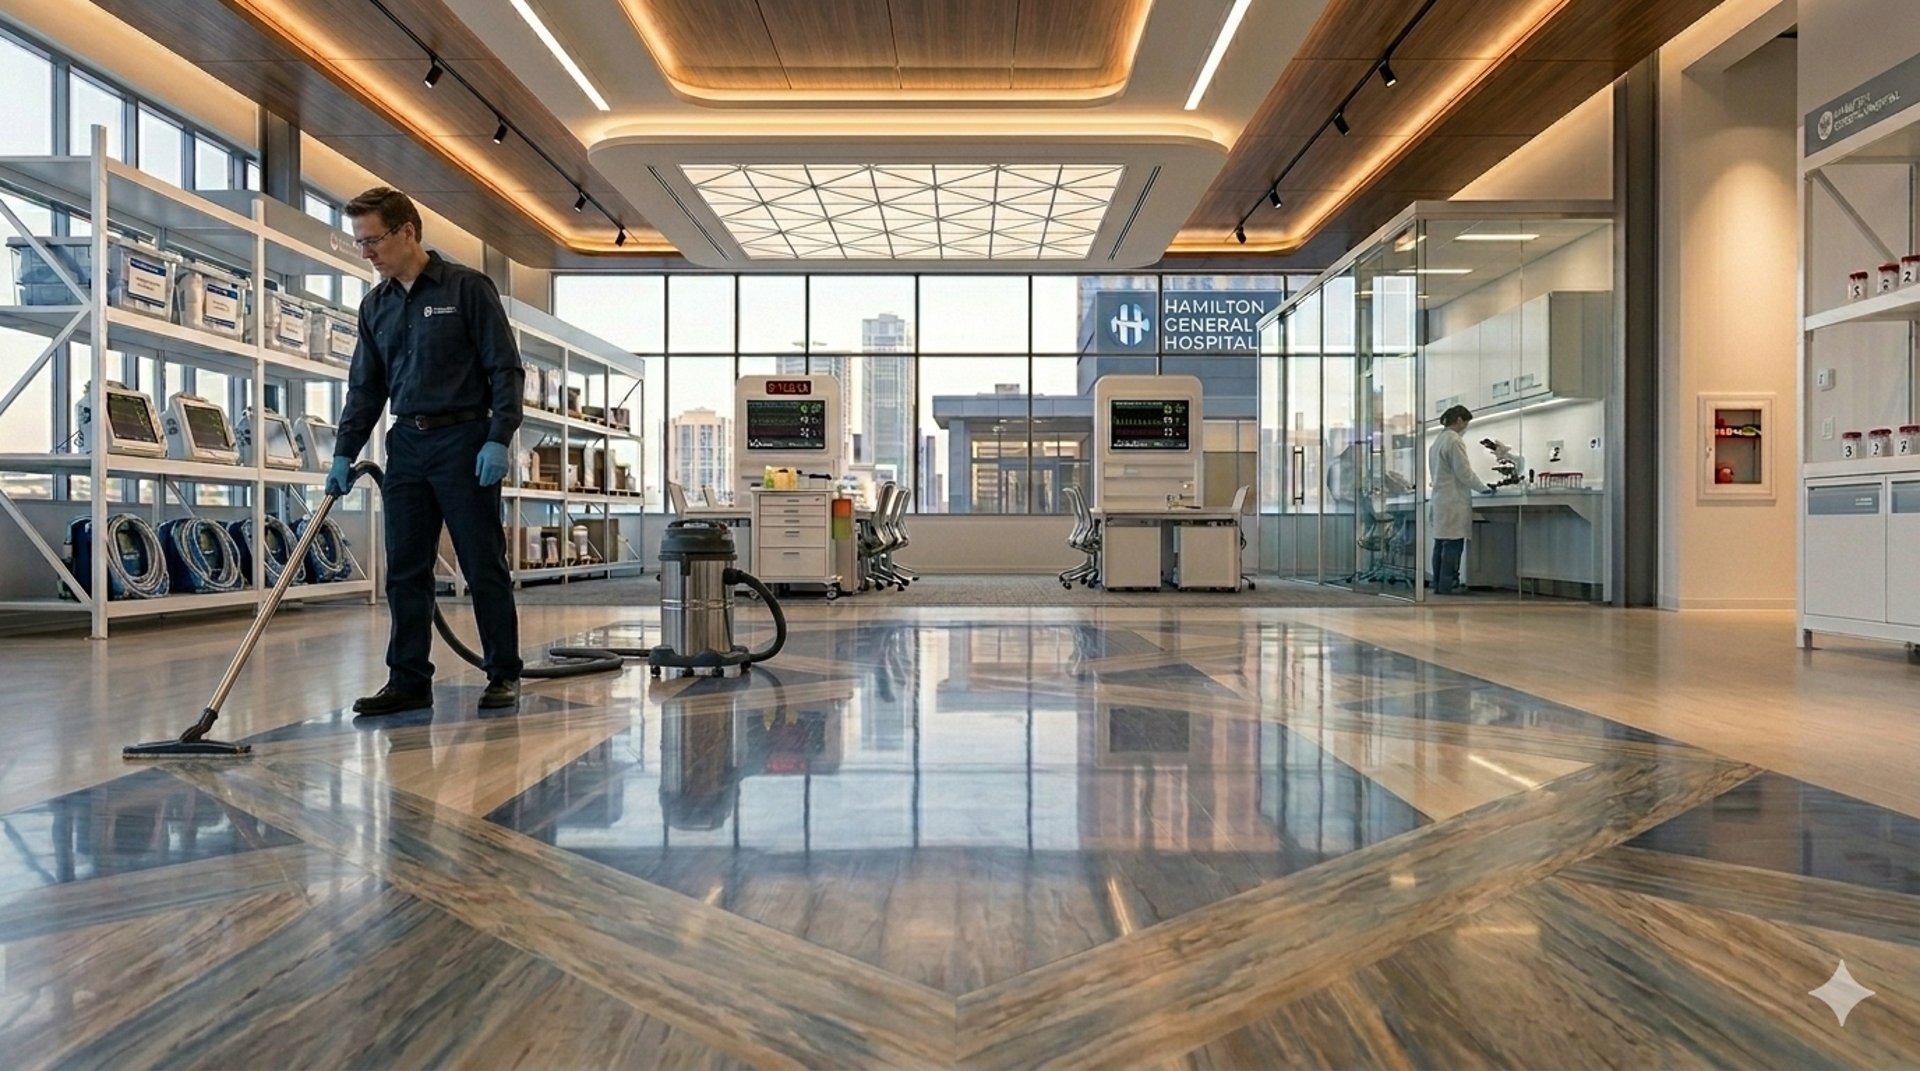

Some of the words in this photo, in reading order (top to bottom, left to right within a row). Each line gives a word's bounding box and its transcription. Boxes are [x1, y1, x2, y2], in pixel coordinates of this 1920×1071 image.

[1165, 300, 1264, 314] HAMILTON
[1165, 318, 1253, 332] GENERAL
[1165, 336, 1258, 350] HOSPITAL
[1845, 445, 1852, 457] 3
